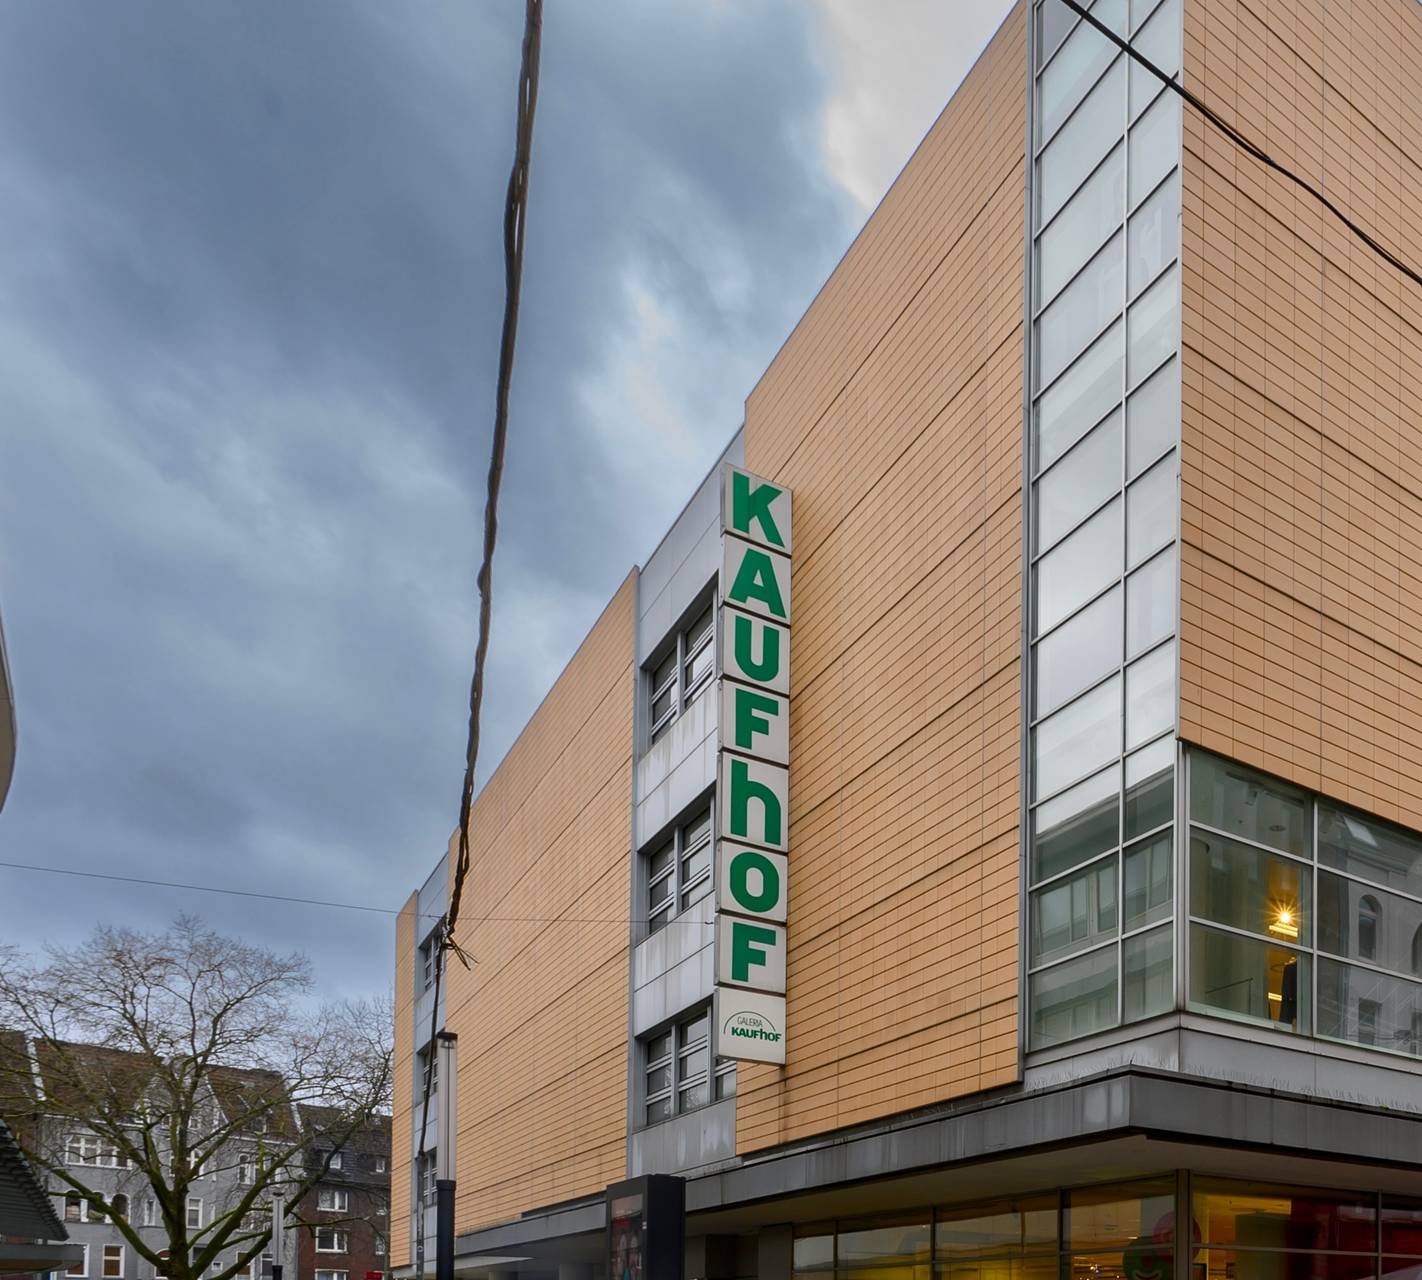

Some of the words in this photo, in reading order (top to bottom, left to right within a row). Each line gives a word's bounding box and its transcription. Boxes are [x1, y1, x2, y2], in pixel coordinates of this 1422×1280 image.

[728, 470, 786, 982] KAUFhOF
[737, 1016, 763, 1027] GALERIA
[731, 1027, 782, 1042] KAUFhOF
